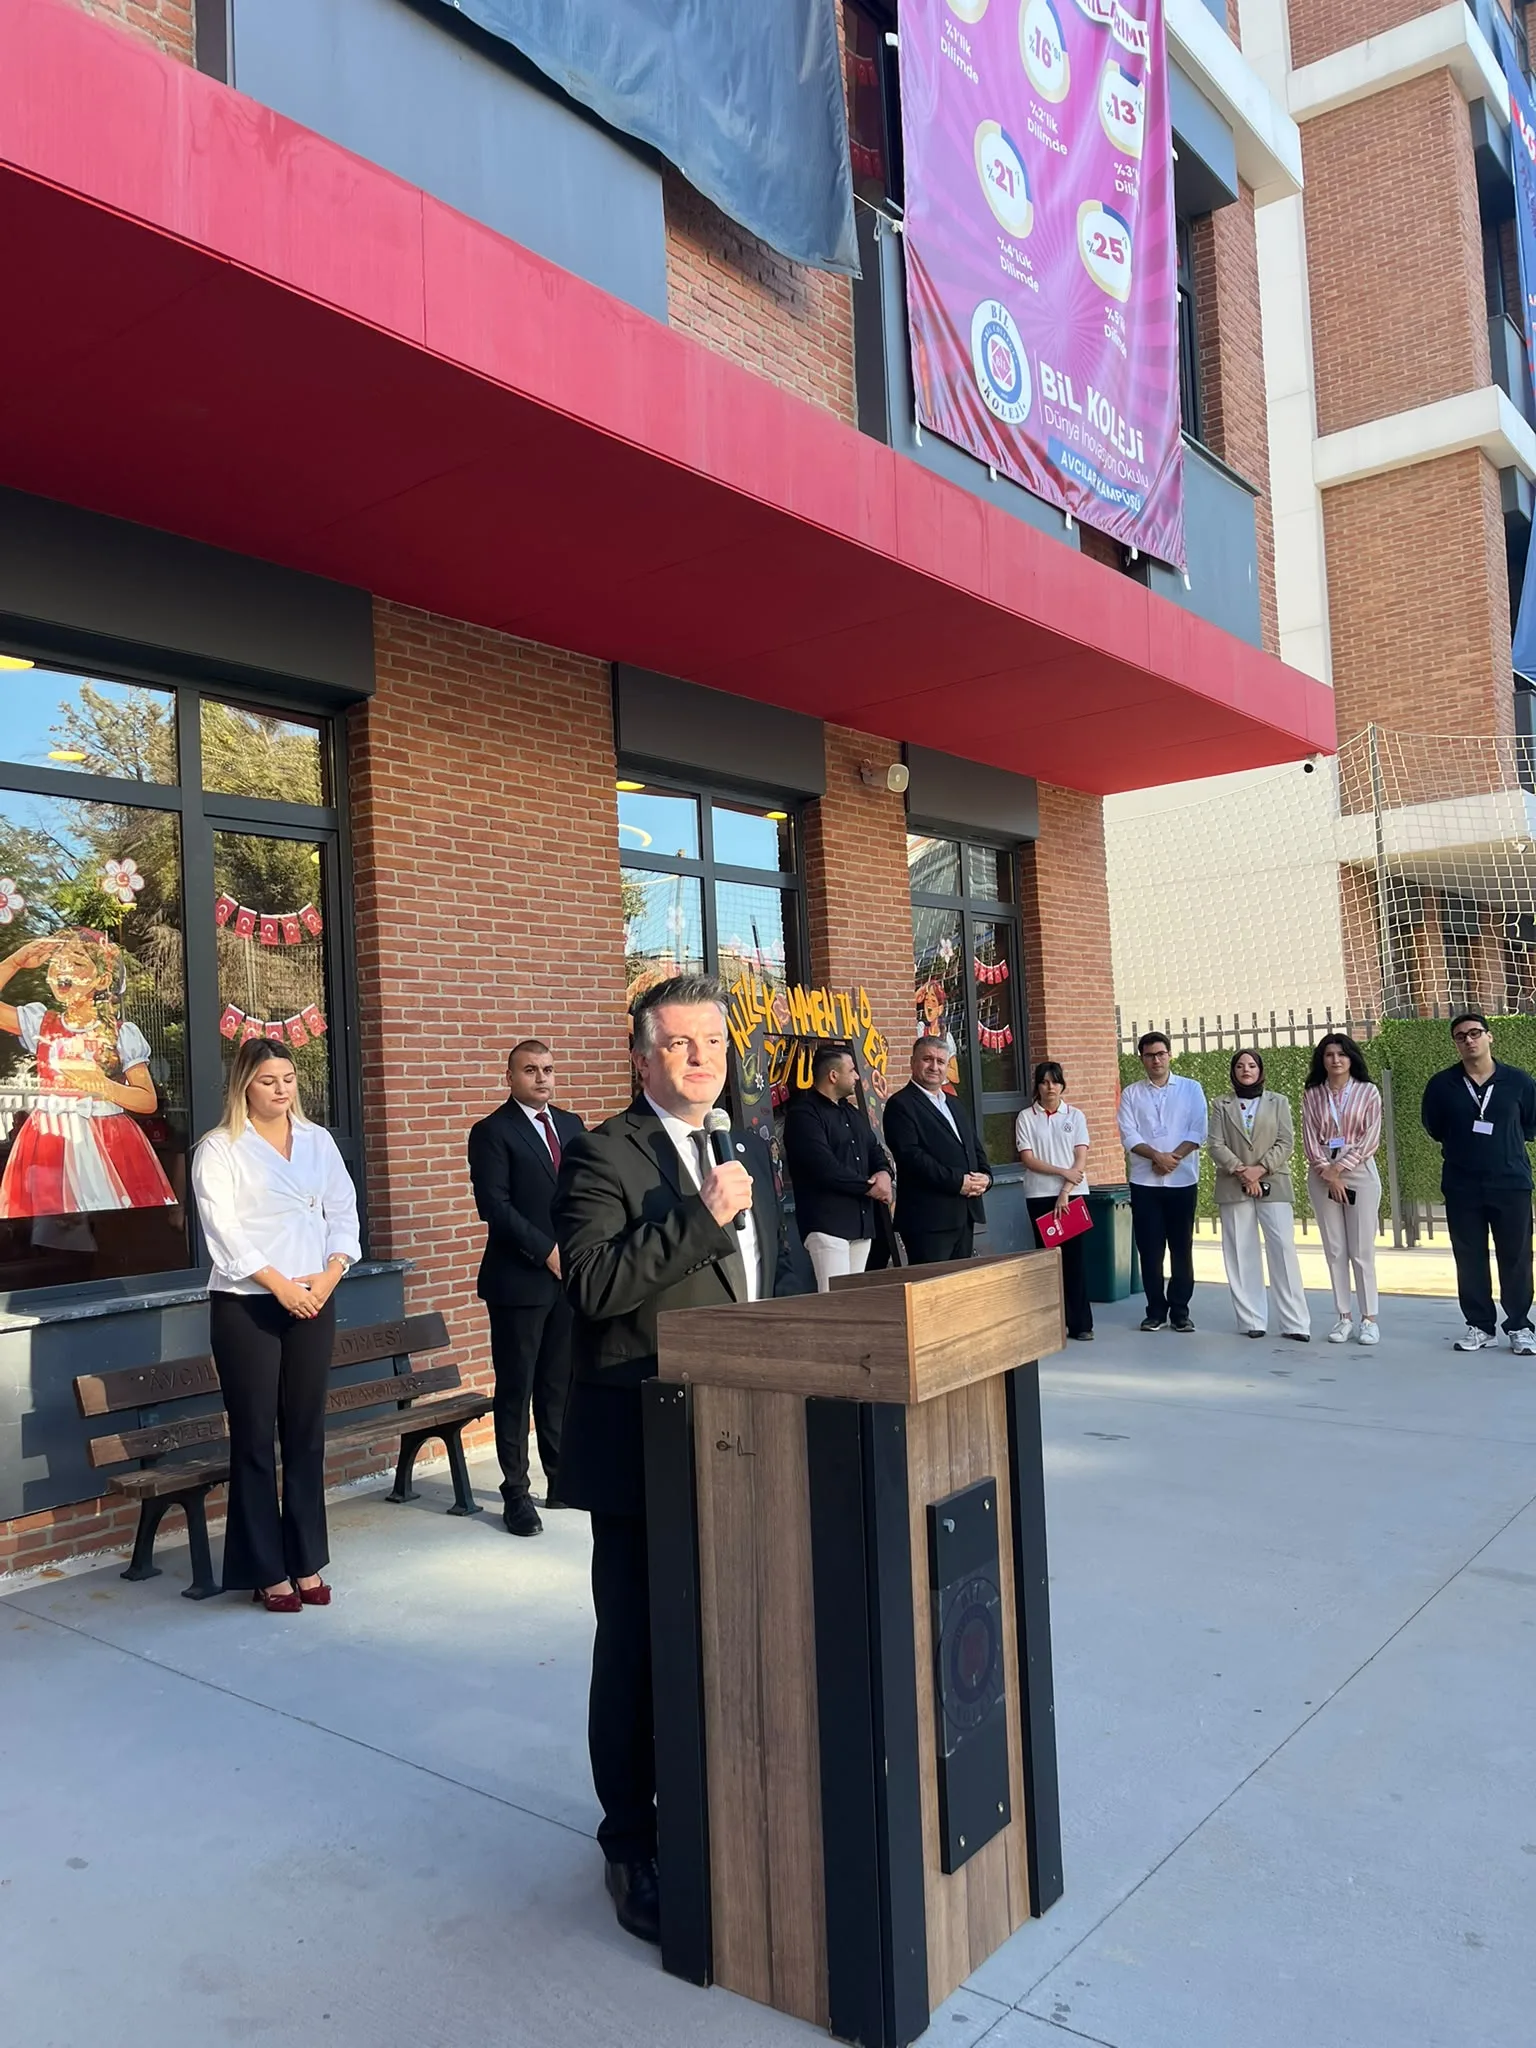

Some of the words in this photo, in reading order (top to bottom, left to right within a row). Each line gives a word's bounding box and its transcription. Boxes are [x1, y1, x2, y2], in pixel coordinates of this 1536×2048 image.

[940, 36, 979, 84] Dilimde
[1027, 117, 1068, 155] Dilimde
[1029, 100, 1058, 134] %2'lik
[999, 255, 1040, 293] Dilimde
[1044, 404, 1080, 441] Dünya
[1118, 461, 1149, 489] Okulu
